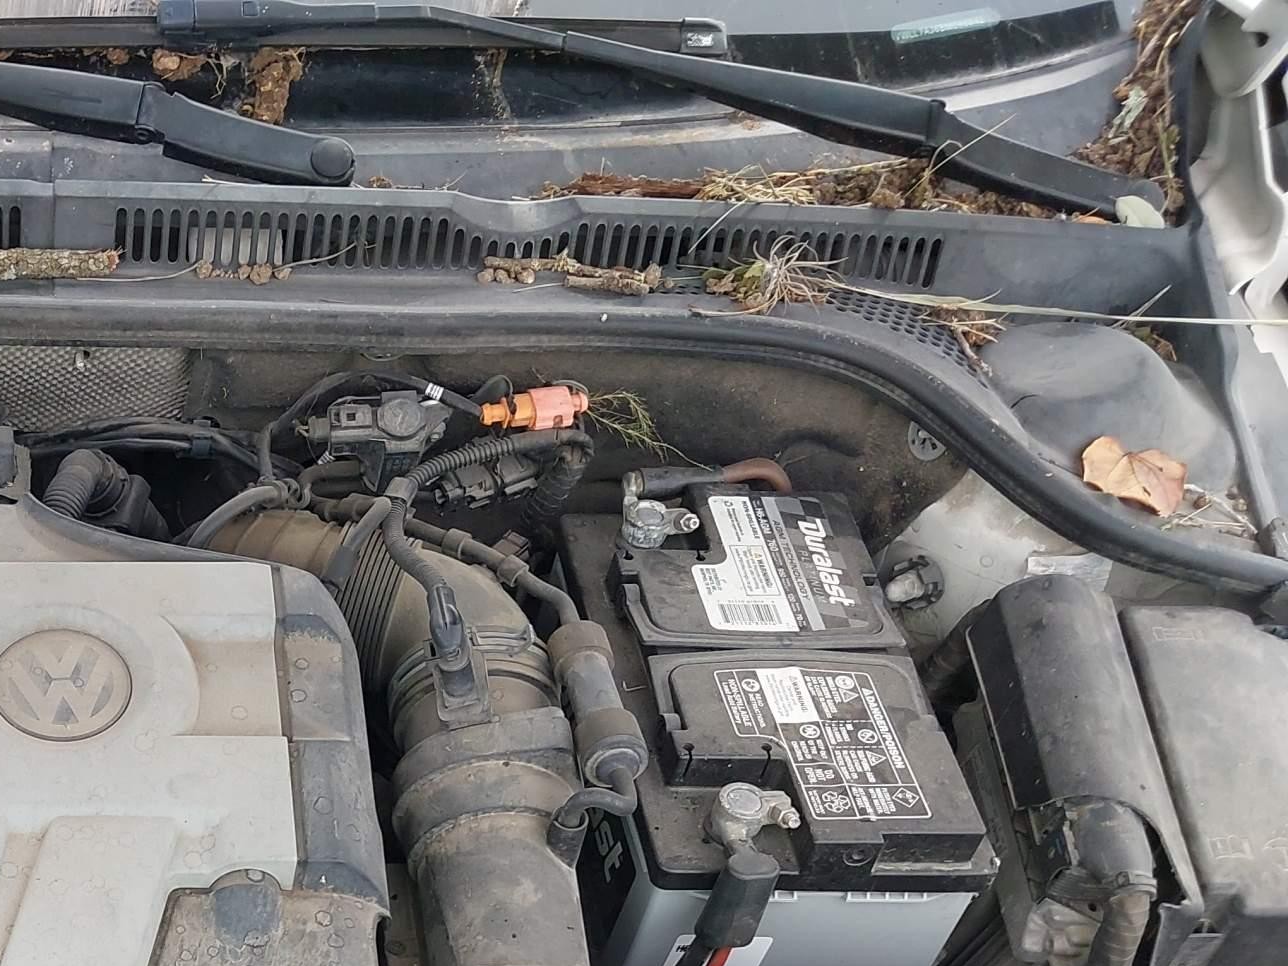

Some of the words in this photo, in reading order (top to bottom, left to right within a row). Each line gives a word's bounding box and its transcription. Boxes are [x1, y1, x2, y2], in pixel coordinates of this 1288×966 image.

[772, 520, 787, 539] AGM
[781, 543, 810, 600] TECHNOLOGY
[796, 519, 856, 606] Duralast
[798, 550, 828, 603] PLATINUM
[864, 696, 905, 768] DANGER/POISON
[813, 769, 827, 781] NOT
[823, 769, 835, 779] DO
